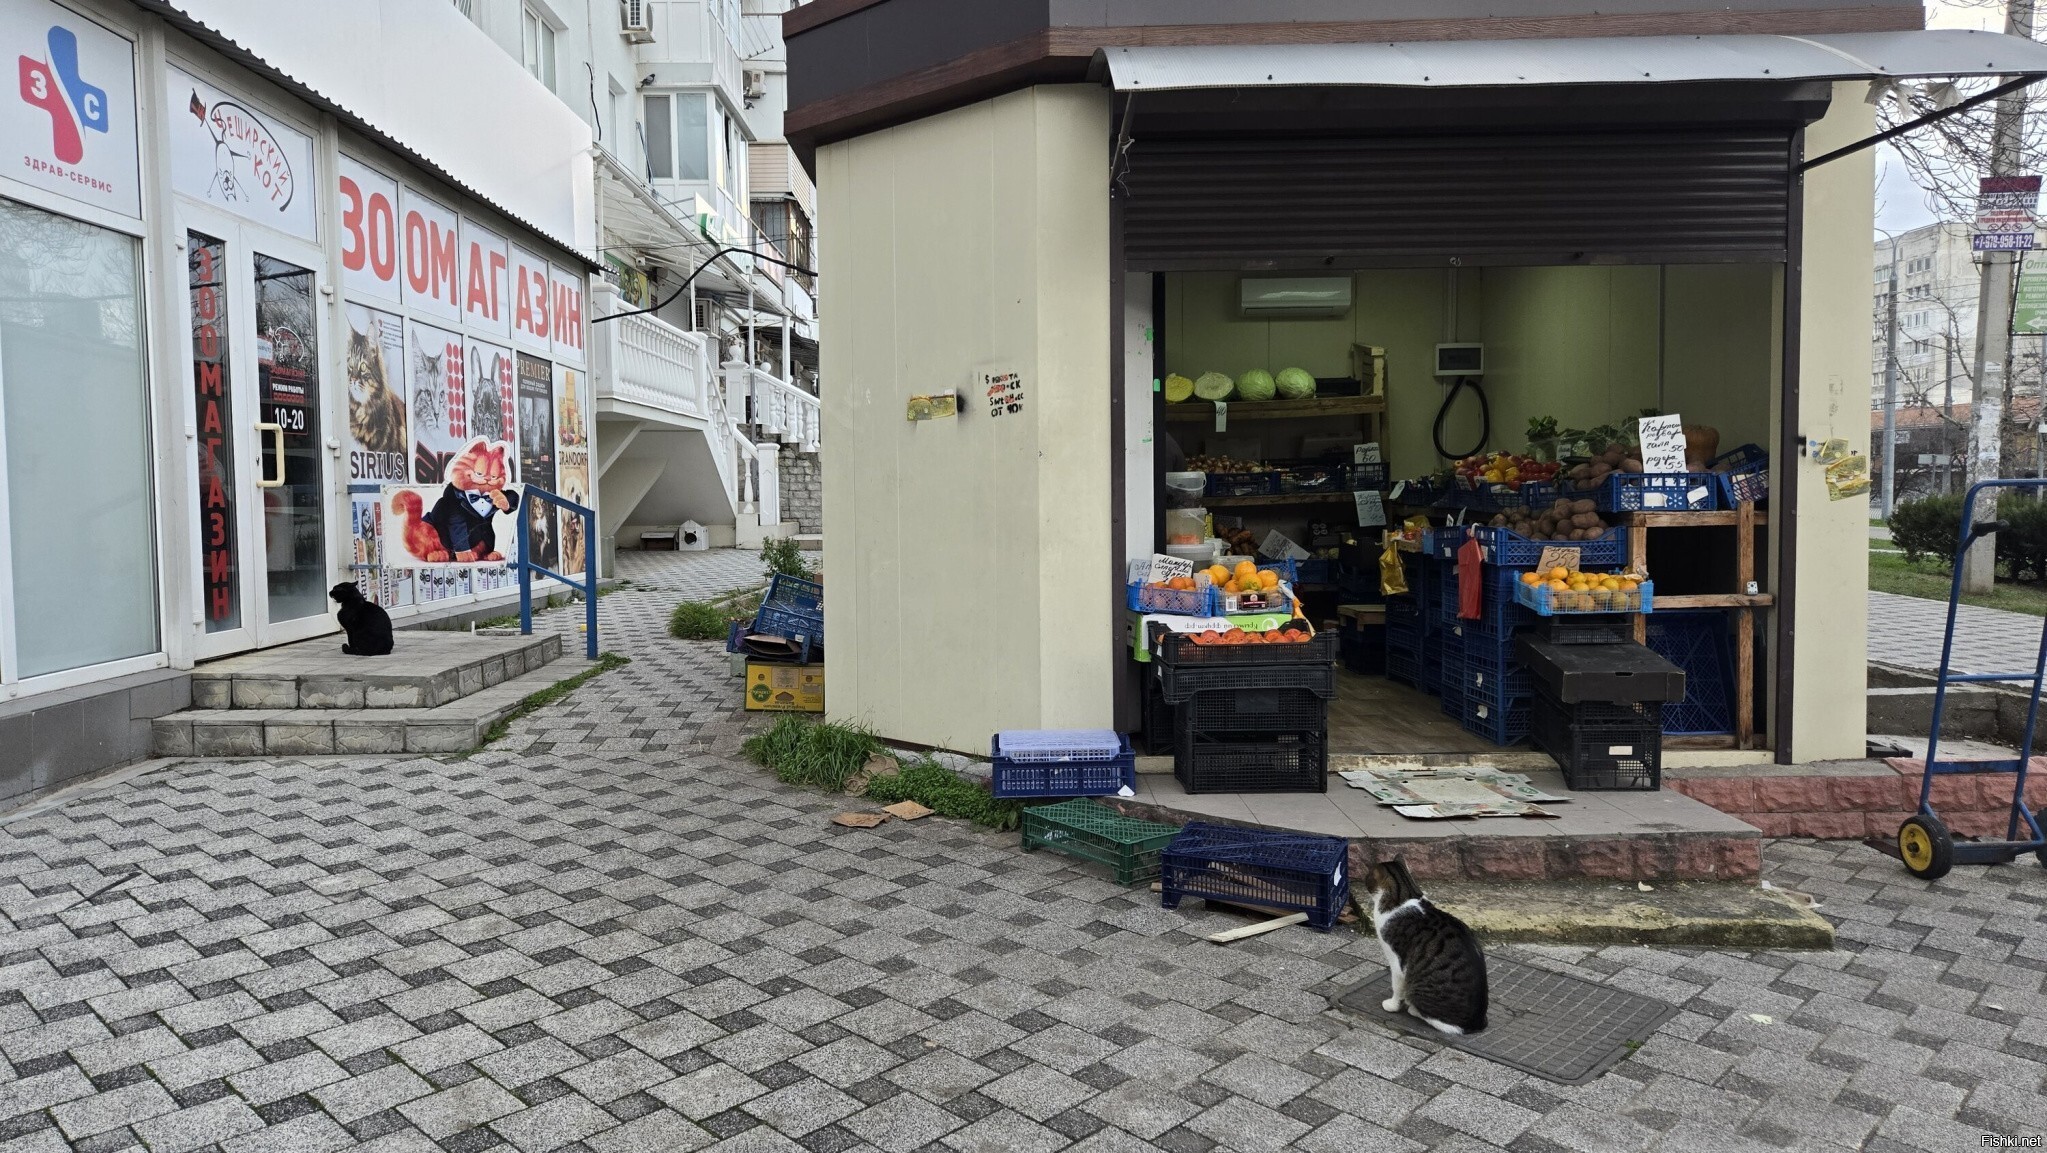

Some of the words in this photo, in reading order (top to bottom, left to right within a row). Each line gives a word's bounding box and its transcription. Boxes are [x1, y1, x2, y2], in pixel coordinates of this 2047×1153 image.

[30, 70, 48, 99] З
[214, 108, 289, 187] ЧЕШИРСКИЙ
[24, 156, 112, 193] ЗДРАВ-СЕРВИС
[253, 155, 283, 201] КОТ
[340, 176, 583, 350] ЗООМАГАЗИН
[197, 247, 230, 620] ЗООМАГАЗИН
[275, 407, 304, 430] 10-20
[350, 450, 405, 481] SIRIUS
[1546, 552, 1578, 568] 250
